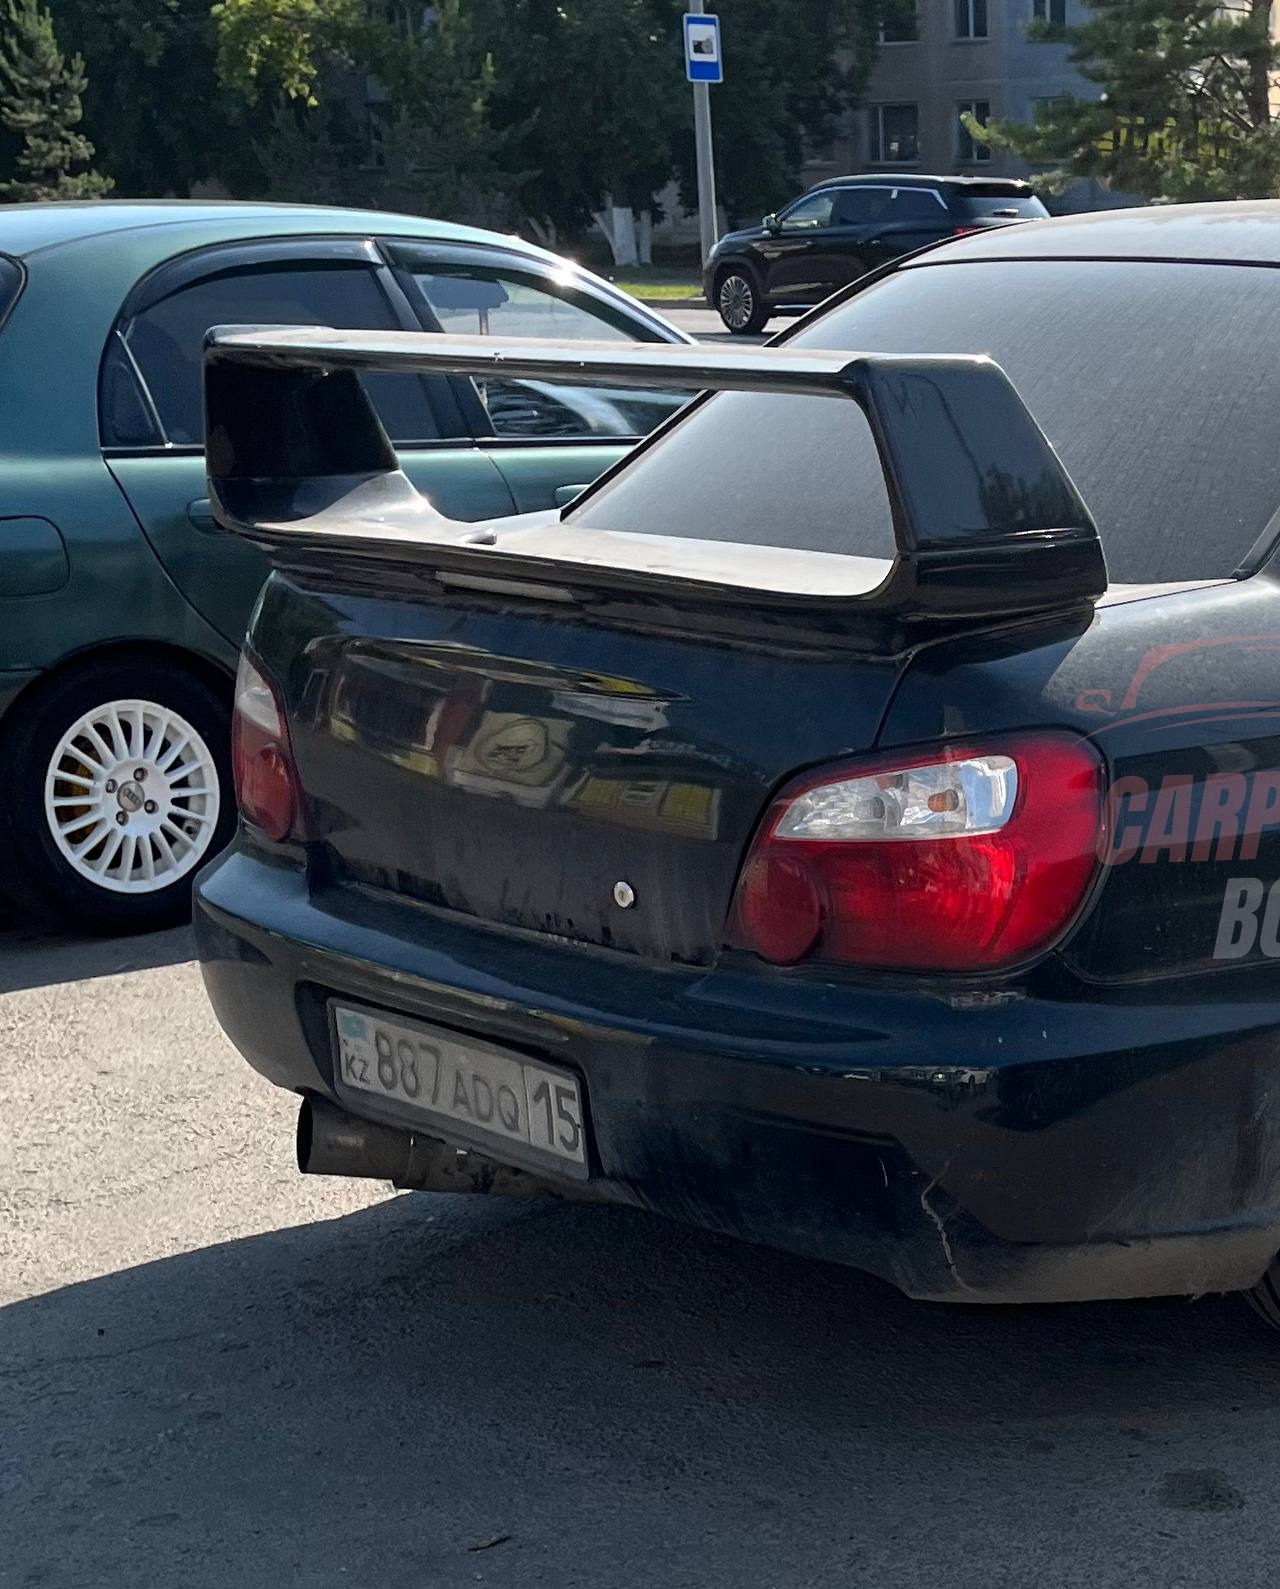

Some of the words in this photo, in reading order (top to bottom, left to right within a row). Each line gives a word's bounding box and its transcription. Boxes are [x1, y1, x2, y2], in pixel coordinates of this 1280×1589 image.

[344, 1052, 370, 1085] KZ
[374, 1029, 440, 1105] 887
[452, 1069, 520, 1132] ADQ
[533, 1081, 580, 1151] 15
